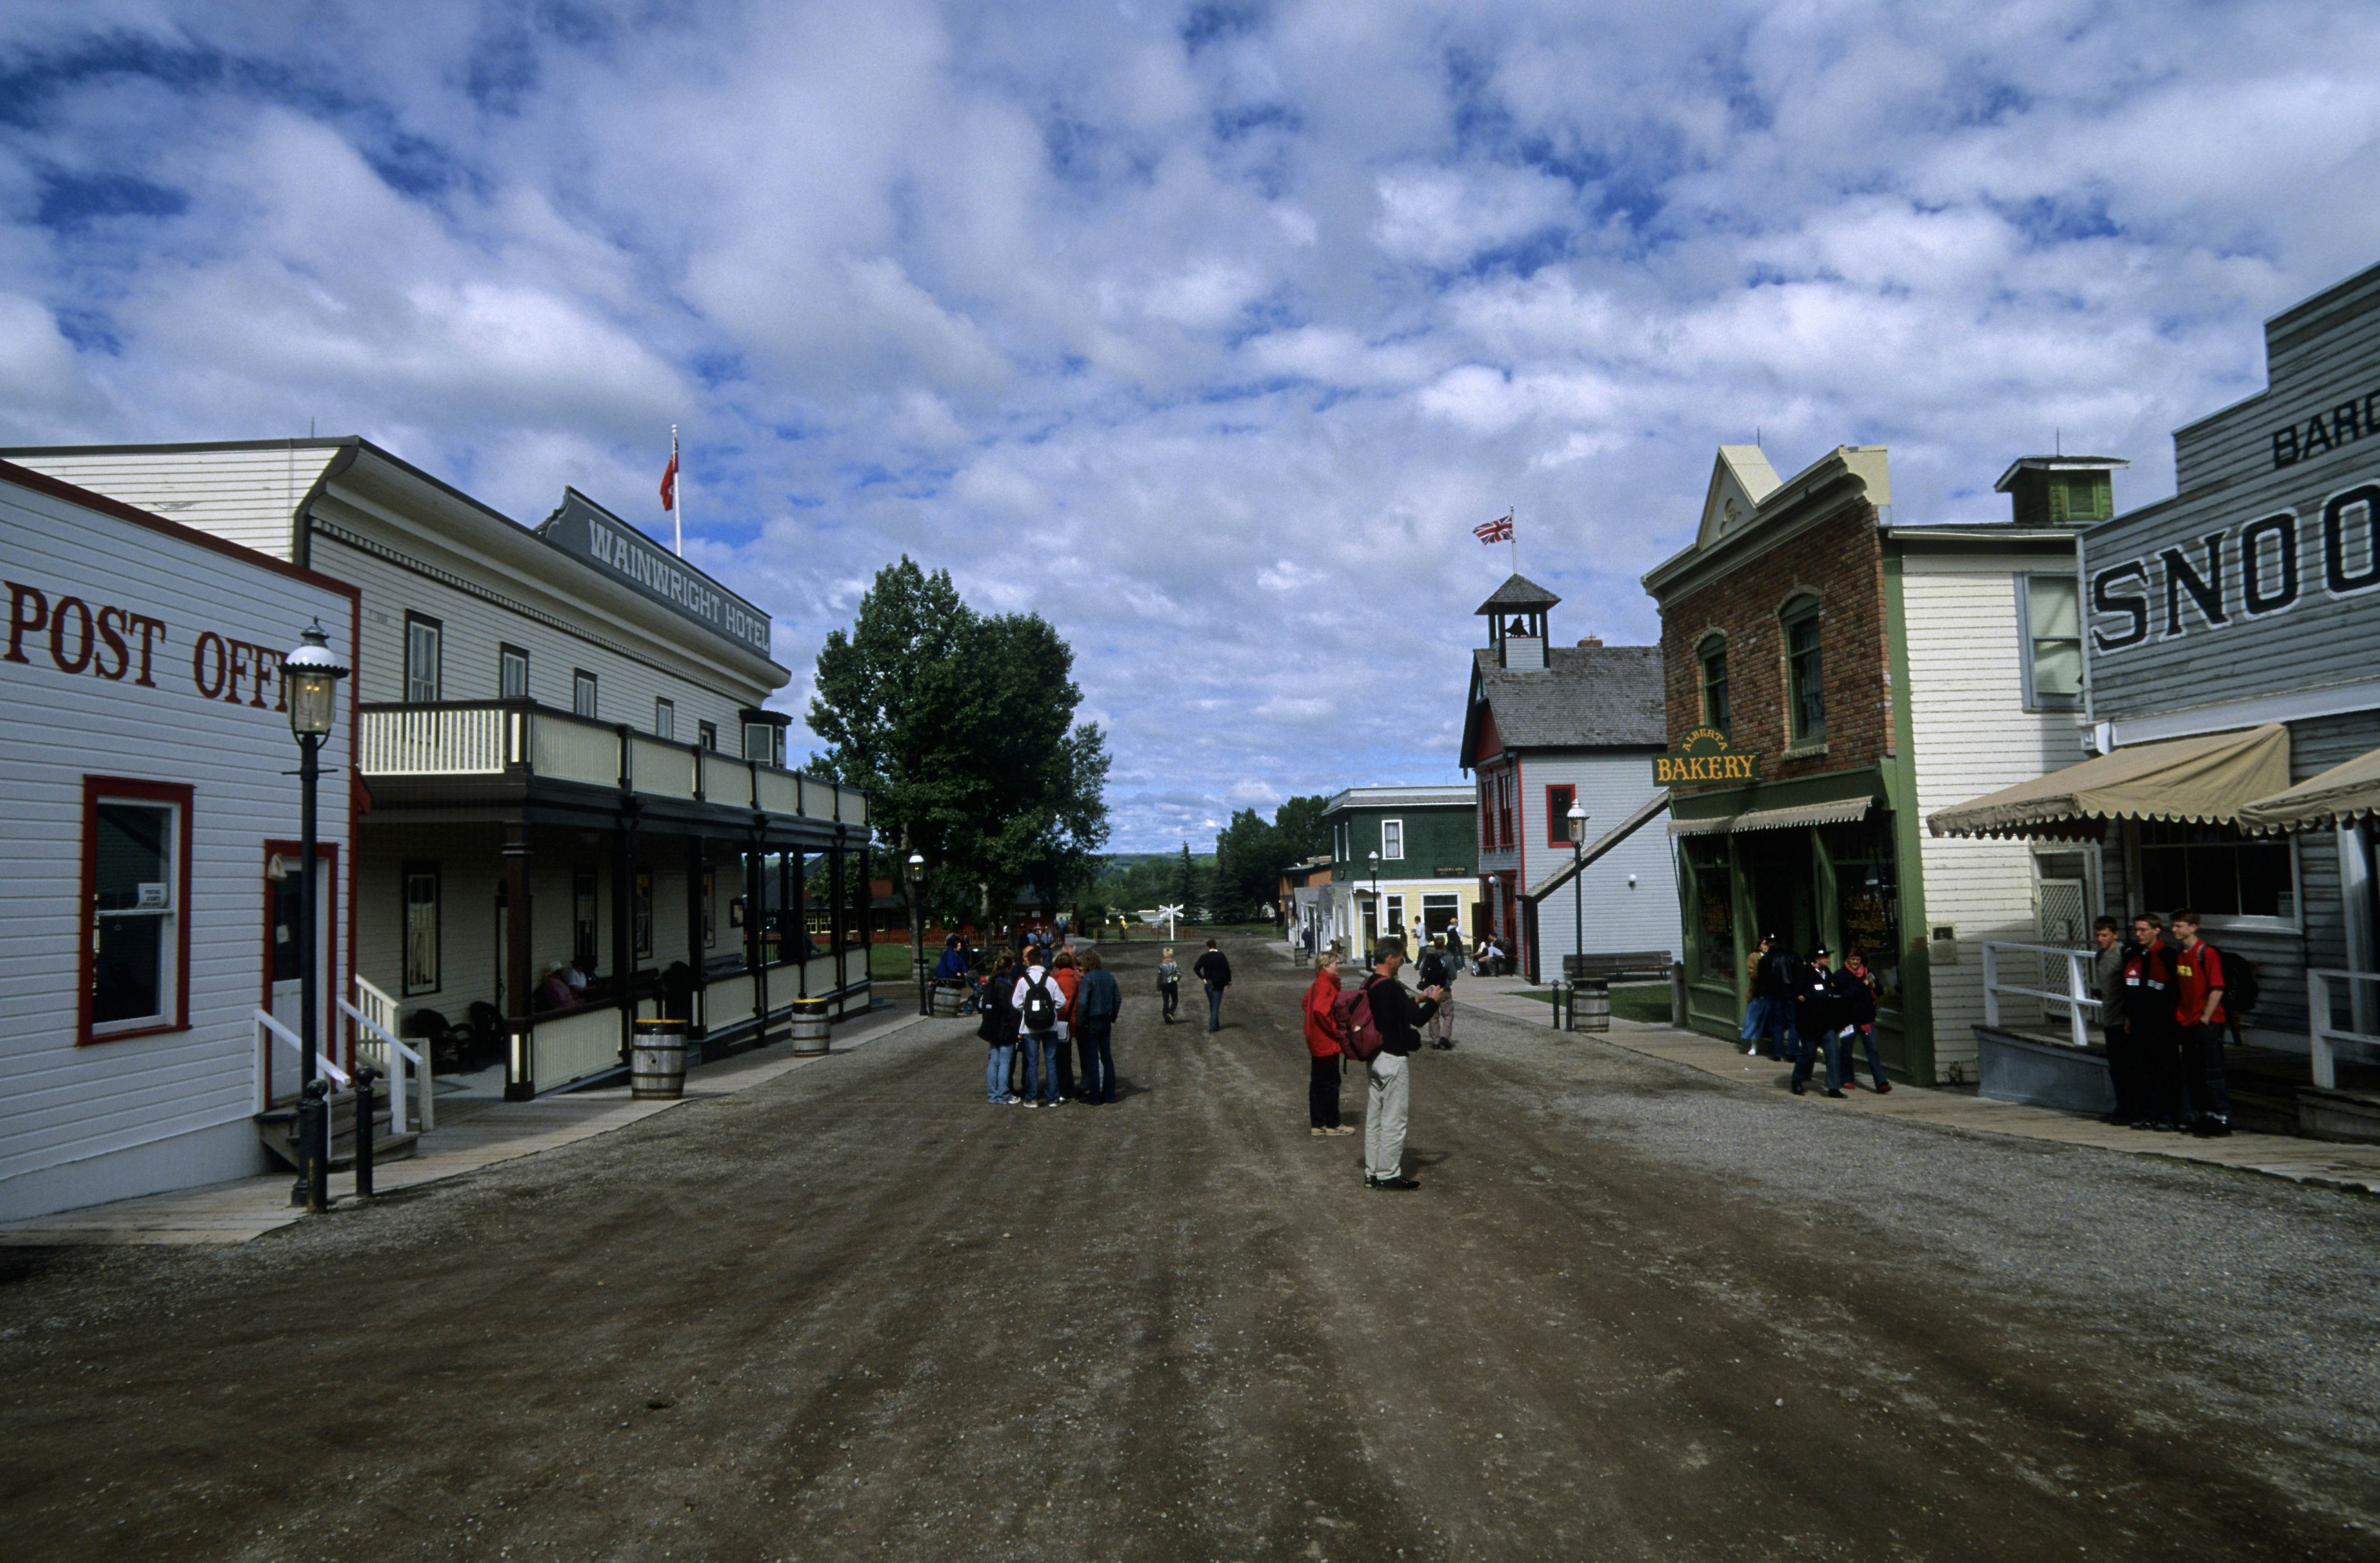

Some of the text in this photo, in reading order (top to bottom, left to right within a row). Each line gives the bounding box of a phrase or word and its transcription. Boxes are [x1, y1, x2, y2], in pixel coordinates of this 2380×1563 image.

[589, 518, 769, 652] WAINWRIGHT HOTEL
[3, 580, 166, 687] POST
[1656, 754, 1755, 782] BAKERY
[1682, 728, 1728, 752] ALBERTA
